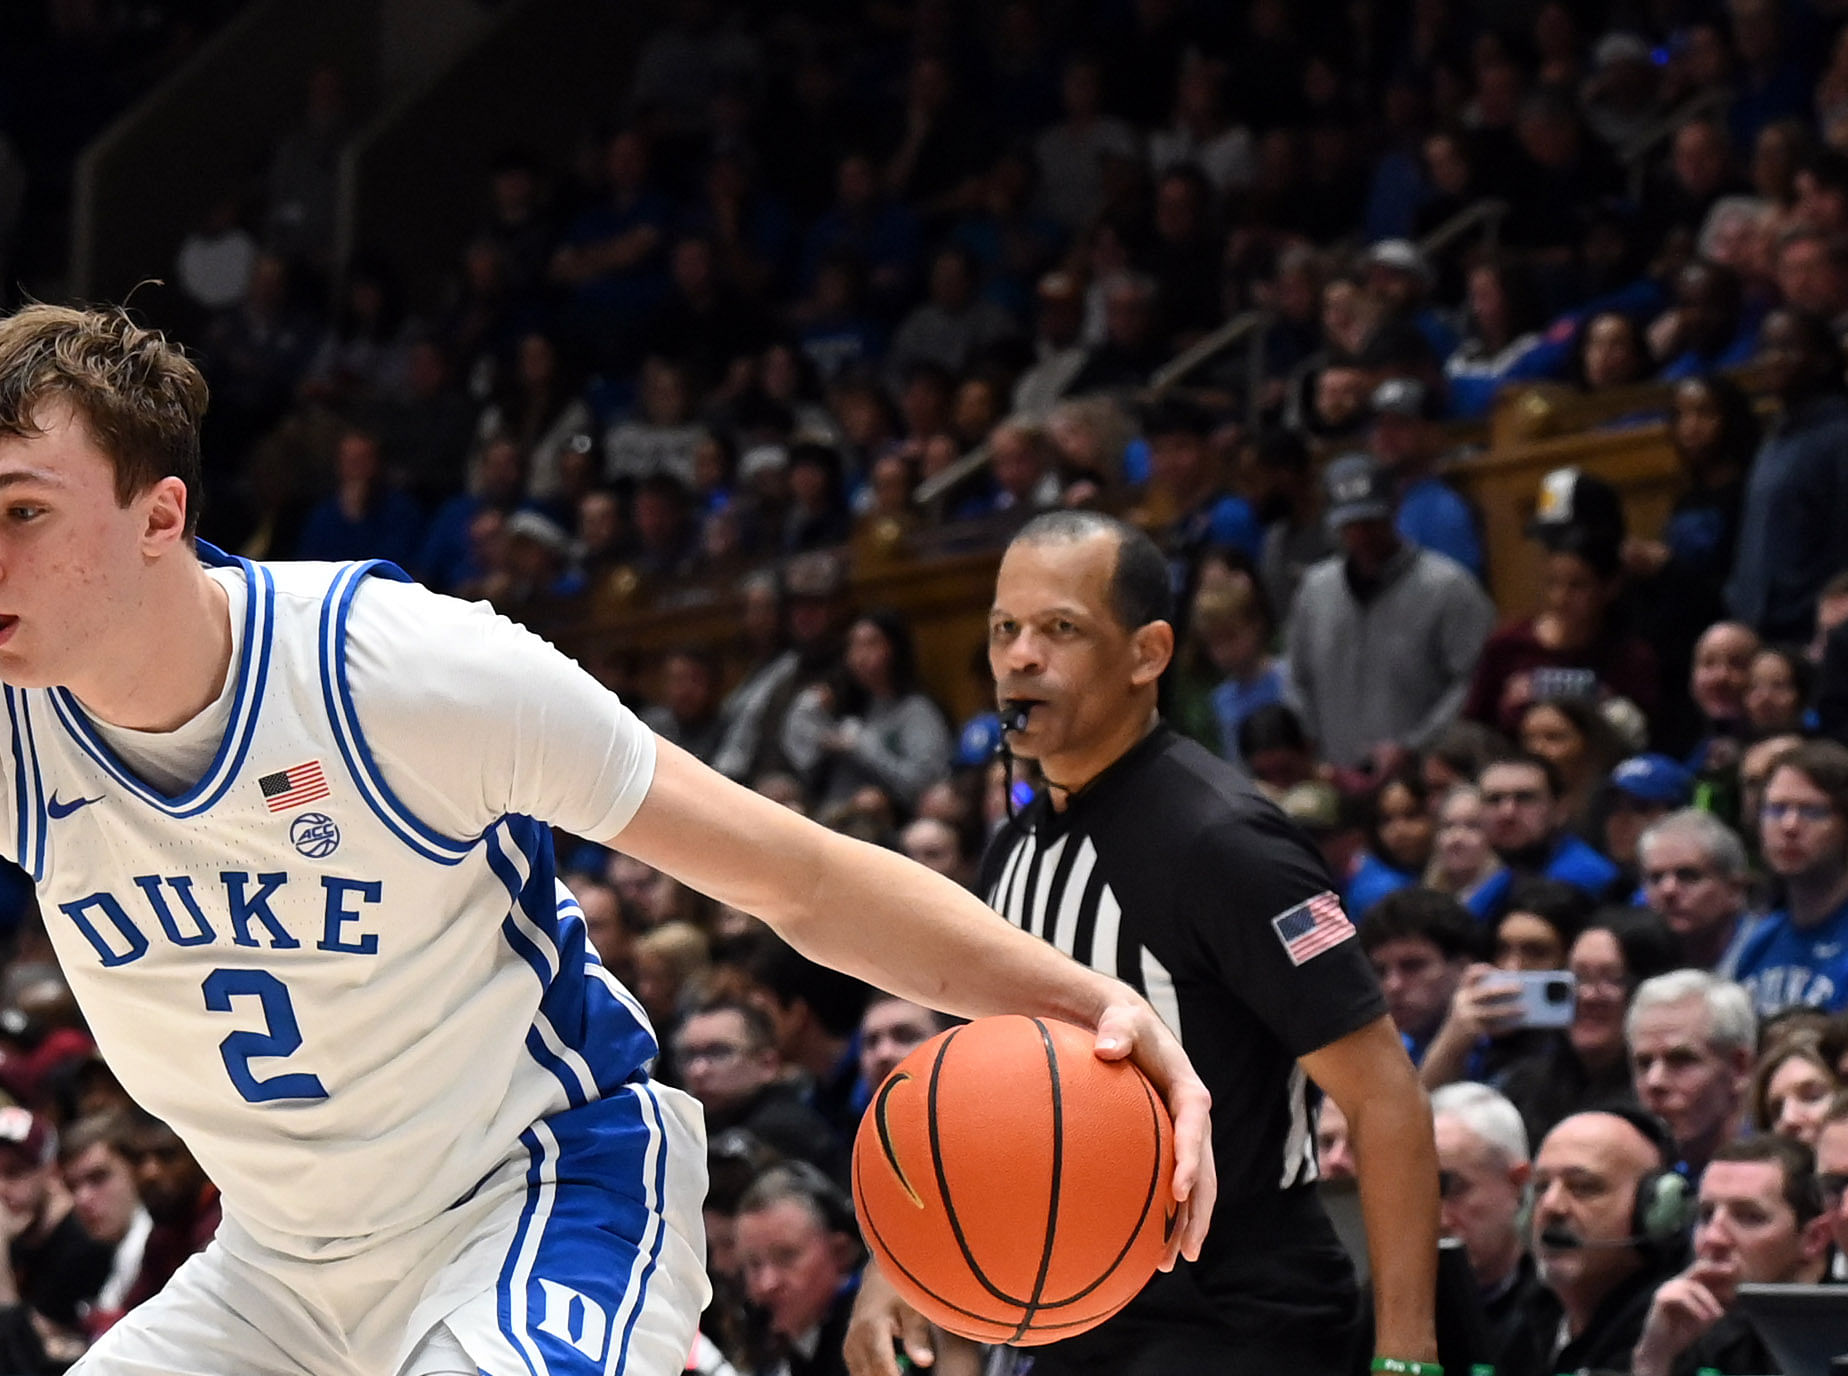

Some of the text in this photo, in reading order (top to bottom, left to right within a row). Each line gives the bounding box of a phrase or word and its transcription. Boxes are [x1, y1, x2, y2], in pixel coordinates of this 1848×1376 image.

[297, 823, 336, 841] ACC
[58, 871, 382, 967] DUKE
[201, 967, 330, 1103] 2
[537, 1278, 606, 1362] D
